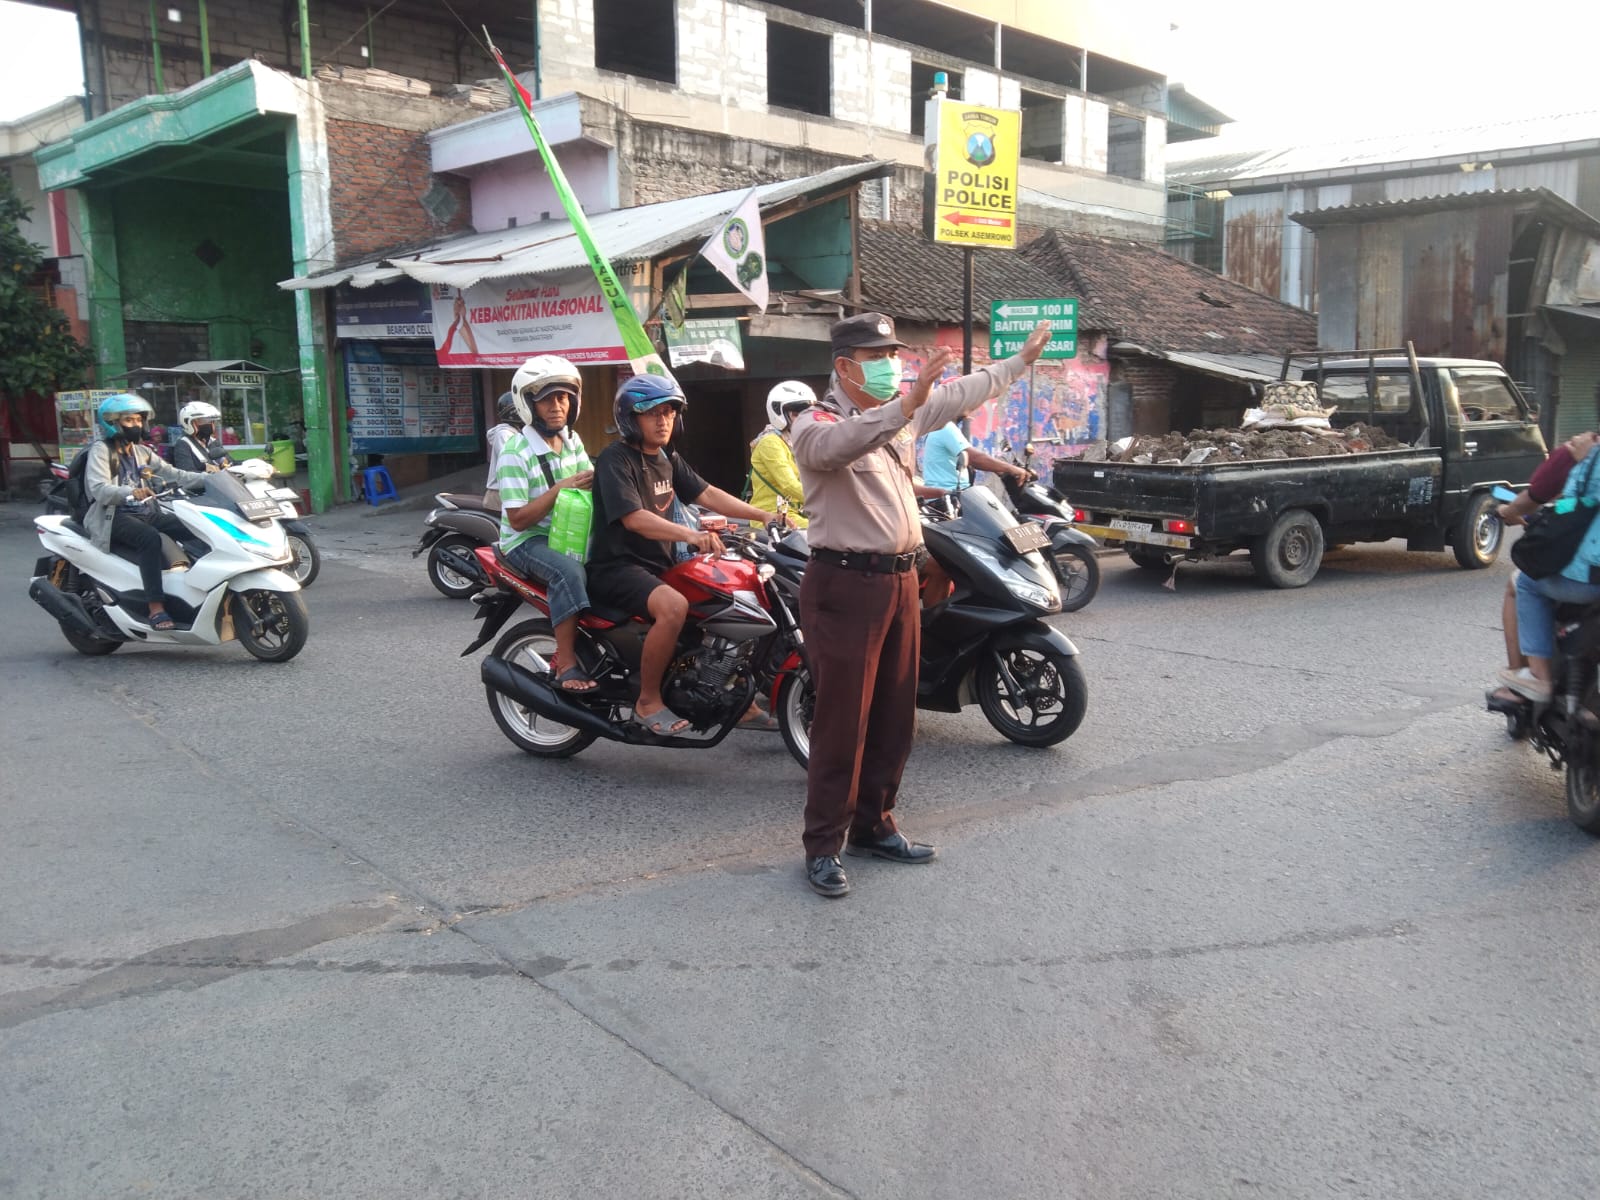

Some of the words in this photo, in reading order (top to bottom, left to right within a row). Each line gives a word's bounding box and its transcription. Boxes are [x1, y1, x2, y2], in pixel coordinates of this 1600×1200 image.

[948, 171, 1009, 191] POLISI
[944, 189, 1012, 208] POLICE
[940, 228, 969, 238] POLSEK
[971, 231, 1012, 241] ASEMROWO
[469, 302, 541, 324] KEBANGKITAN
[541, 295, 604, 318] NASIONAL
[1041, 304, 1061, 315] 100
[1063, 304, 1074, 315] M
[416, 323, 432, 335] CELL
[994, 320, 1034, 331] BAITUR
[222, 375, 241, 383] ISMA
[243, 375, 259, 383] CELL
